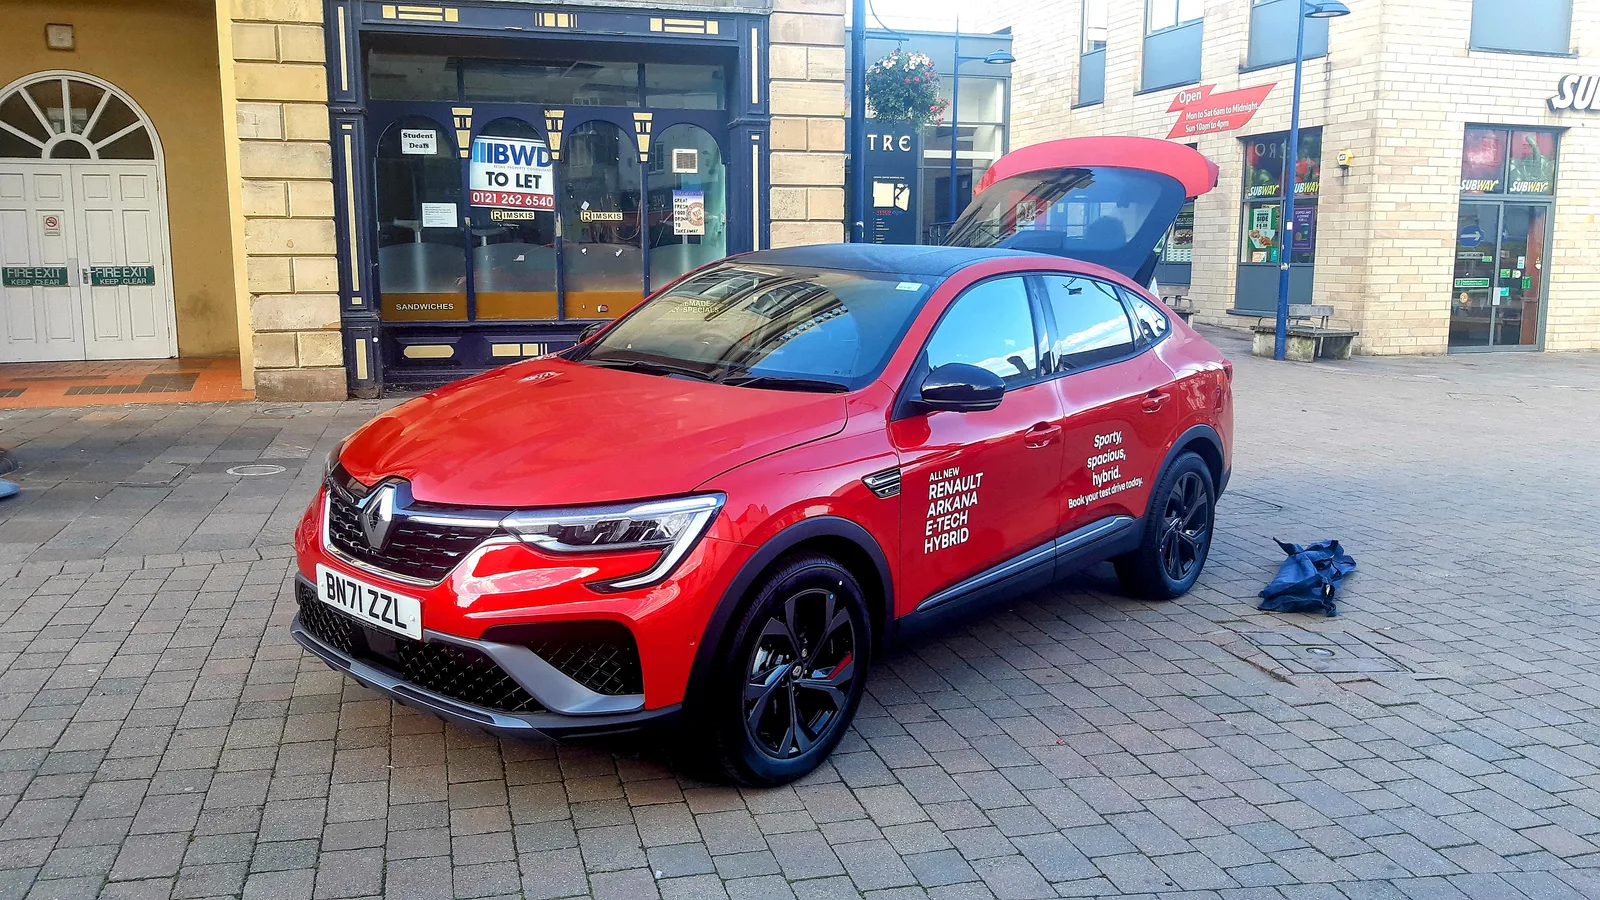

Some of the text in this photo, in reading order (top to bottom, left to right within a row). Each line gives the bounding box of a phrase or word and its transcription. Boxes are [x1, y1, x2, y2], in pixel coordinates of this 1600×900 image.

[1179, 91, 1202, 105] Open
[1185, 111, 1197, 121] Mon
[1197, 110, 1204, 118] to
[1203, 109, 1213, 118] Sat
[1213, 107, 1225, 116] 6am
[1225, 106, 1232, 114] to
[1185, 120, 1230, 133] Sun 10am to 4pm
[485, 171, 542, 189] TO LET
[1293, 181, 1320, 193] UBWAY
[1460, 179, 1499, 190] SUBWAY
[1510, 181, 1549, 192] SUBWAY
[1248, 184, 1279, 196] SUBWAY
[472, 192, 554, 207] 0121 262 6540
[493, 211, 534, 221] RIMSKIS
[582, 211, 623, 222] RIMSKIS
[7, 267, 62, 278] FIRE EXIT
[96, 266, 149, 278] FIRE EXIT
[1093, 430, 1123, 449] Sporty,
[1086, 448, 1126, 470] spacious,
[929, 466, 960, 482] ALL NEW
[1092, 465, 1121, 487] hybrid.
[928, 472, 984, 500] RENAULT
[1068, 477, 1144, 509] Book your test drive today.
[926, 491, 978, 519] ARKANA
[925, 510, 969, 536] E-TECH
[924, 527, 970, 554] HYBRID
[325, 571, 407, 630] BN71 ZZL
